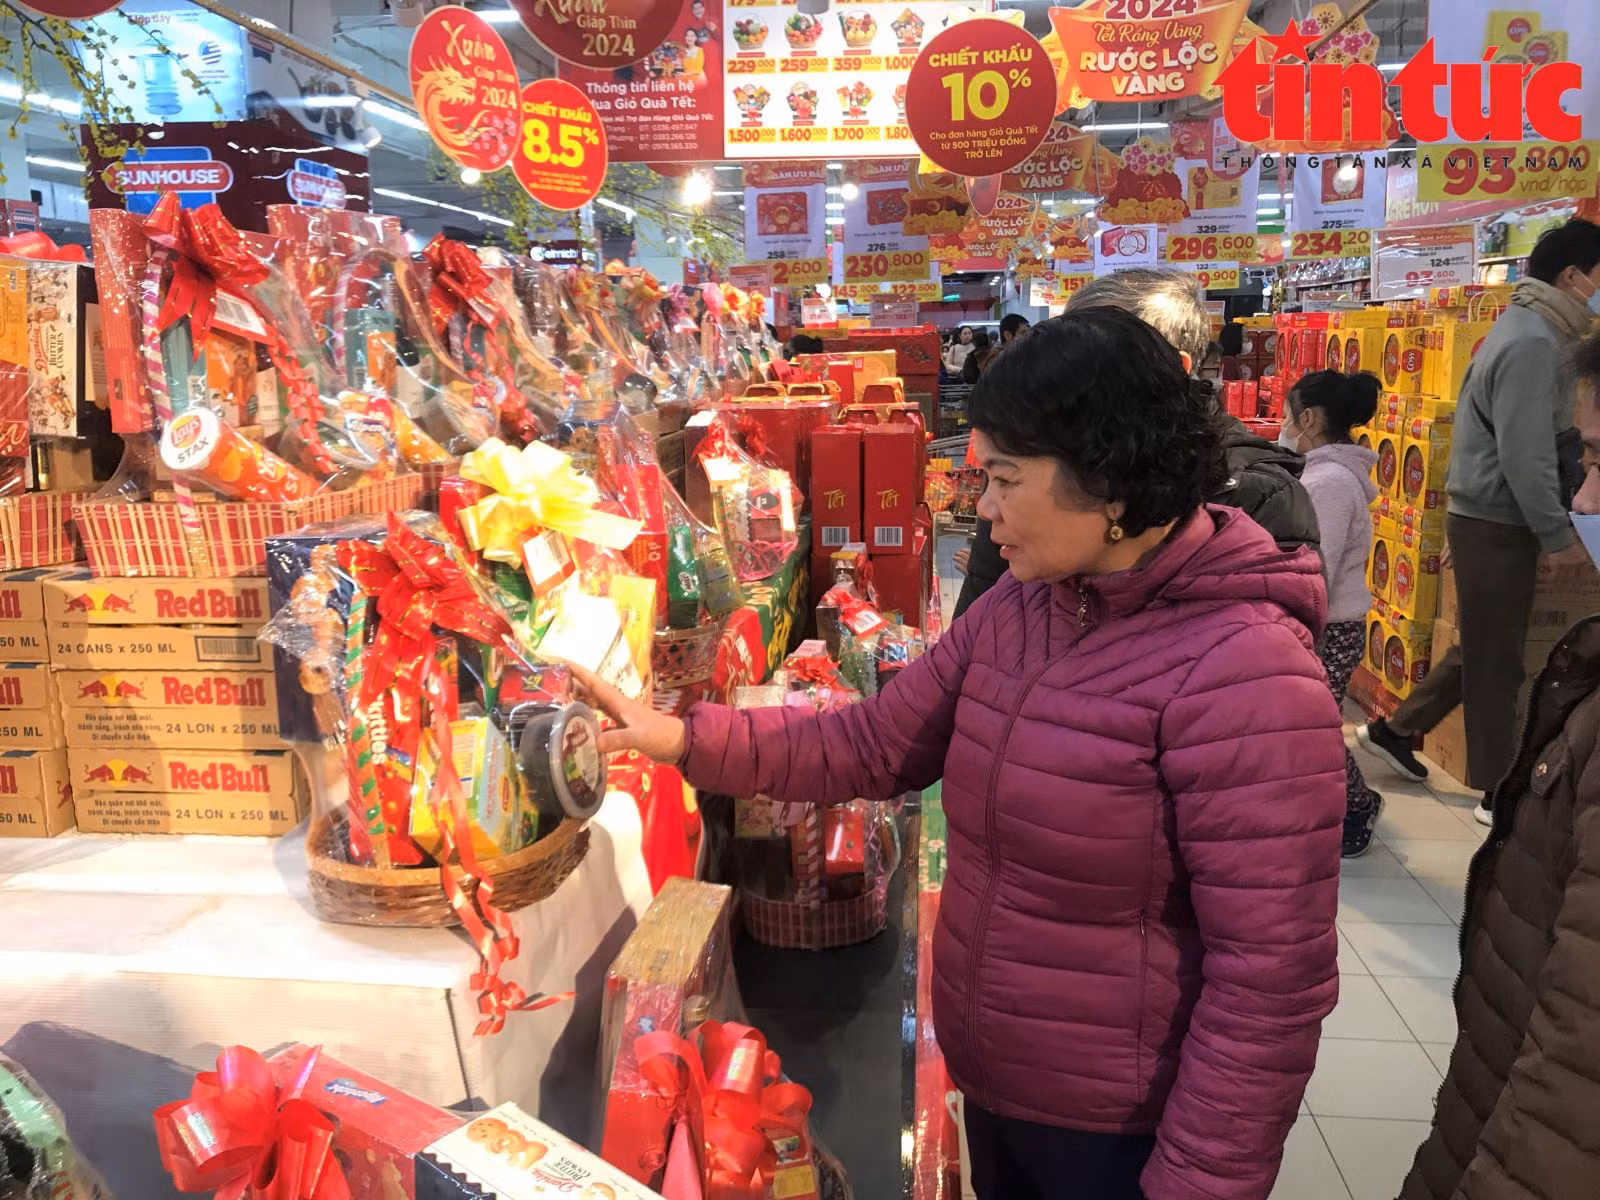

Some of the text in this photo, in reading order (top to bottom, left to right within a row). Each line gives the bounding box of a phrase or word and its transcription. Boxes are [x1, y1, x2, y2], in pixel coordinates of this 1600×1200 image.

[1105, 0, 1198, 20] 2024
[577, 15, 637, 31] Giáp Thìn
[582, 33, 635, 57] 2024
[928, 42, 1033, 68] CHIẾT KHẤU
[1079, 40, 1219, 73] RƯỚC LỘC
[585, 80, 696, 96] Thông tin liên hệ
[1110, 71, 1186, 97] VÀNG
[479, 85, 518, 110] 2024
[614, 96, 637, 110] Giỏ
[640, 96, 668, 110] Quà
[670, 94, 697, 109] Tết:
[941, 68, 1033, 122] 10%
[522, 101, 558, 118] CHIẾT
[929, 125, 1039, 140] Cho đơn hàng Giỏ Quà Tết
[941, 135, 1027, 150] từ 500 TRIỆU ĐỒNG
[521, 118, 600, 169] 8.5%
[965, 148, 1003, 159] TRỞ LÊN
[1010, 155, 1085, 175] ƯỚC LỘC
[115, 167, 221, 188] SUNHOUSE
[1019, 174, 1064, 189] VÀNG
[996, 198, 1022, 208] 024
[1170, 235, 1256, 260] 296.600
[1292, 230, 1370, 257] 234.20
[845, 252, 924, 278] 230.800
[49, 334, 57, 366] BUTTER
[177, 436, 210, 463] STAX
[155, 588, 263, 620] Red Bull
[0, 636, 40, 648] 50 ML
[57, 643, 72, 655] 24
[76, 643, 114, 655] CANS
[130, 643, 153, 654] 250
[158, 643, 177, 654] ML
[161, 676, 267, 707] Red Bull
[0, 726, 43, 737] 50 ML
[166, 723, 181, 734] 24
[186, 723, 215, 734] LON
[233, 723, 257, 735] 250
[261, 723, 281, 735] ML
[367, 691, 391, 766] kittles
[168, 761, 271, 793] Red Bull
[0, 813, 37, 824] 50 ML
[175, 809, 191, 820] 24
[195, 809, 224, 820] LON
[241, 809, 264, 820] 250
[269, 810, 289, 821] ML
